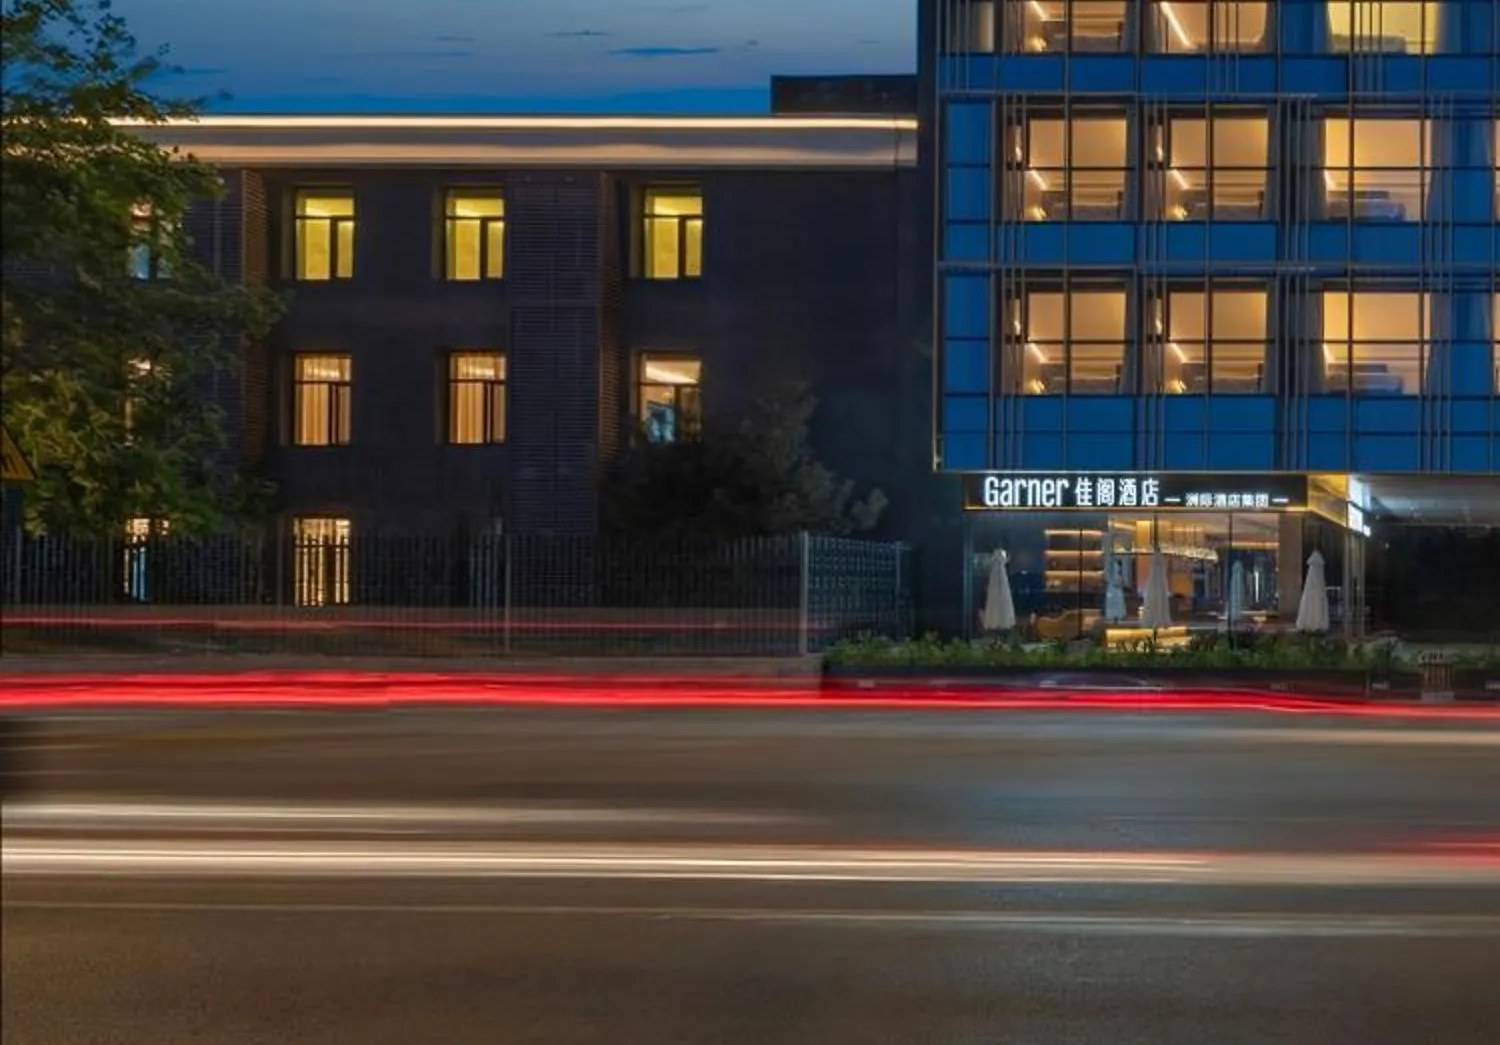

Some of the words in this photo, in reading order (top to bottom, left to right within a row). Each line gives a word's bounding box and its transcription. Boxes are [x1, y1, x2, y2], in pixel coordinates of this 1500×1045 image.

[984, 476, 1070, 506] Garner
[1074, 476, 1160, 506] 佳阁酒店
